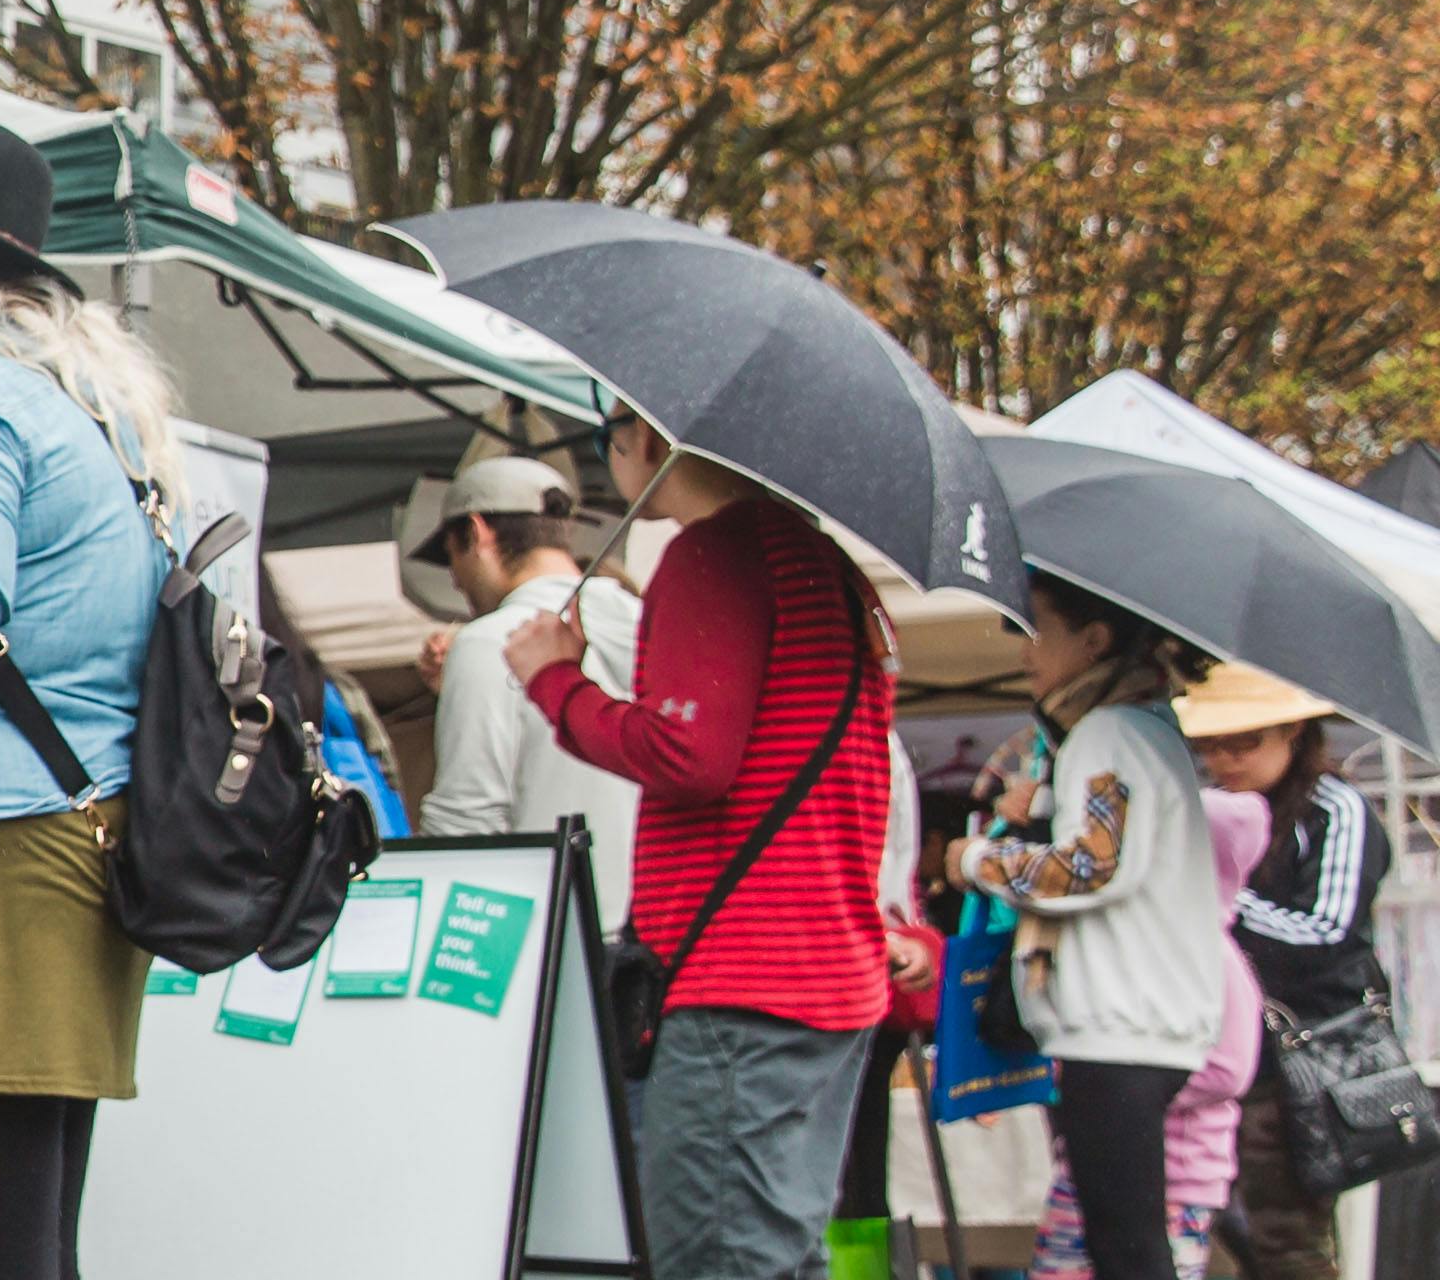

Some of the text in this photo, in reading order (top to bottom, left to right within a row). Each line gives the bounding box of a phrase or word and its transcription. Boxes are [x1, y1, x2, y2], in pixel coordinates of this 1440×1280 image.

[456, 892, 509, 919] Tell us
[447, 914, 491, 936] what
[440, 934, 475, 954] you
